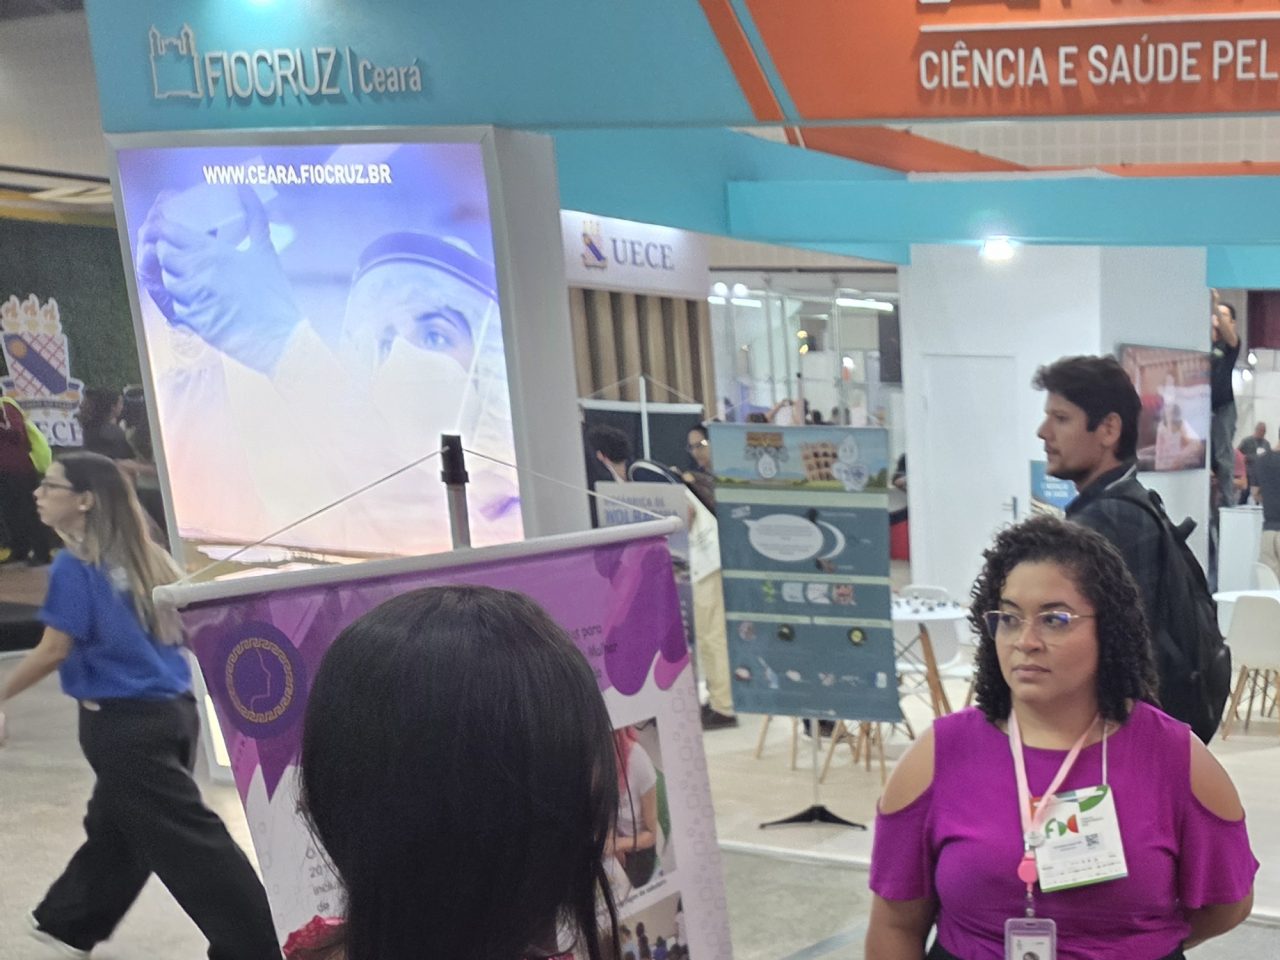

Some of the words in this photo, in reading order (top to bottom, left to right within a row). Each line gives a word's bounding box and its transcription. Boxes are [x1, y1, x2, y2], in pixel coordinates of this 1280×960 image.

[205, 48, 340, 98] FIOCRUZ
[358, 57, 422, 93] Ceará
[919, 42, 1048, 91] CIÊNCIA
[1059, 47, 1078, 84] E
[1088, 34, 1202, 84] SAÚDE
[203, 163, 392, 185] WWW.CEARA.FIOCRUZ.BR
[610, 237, 674, 270] UECE
